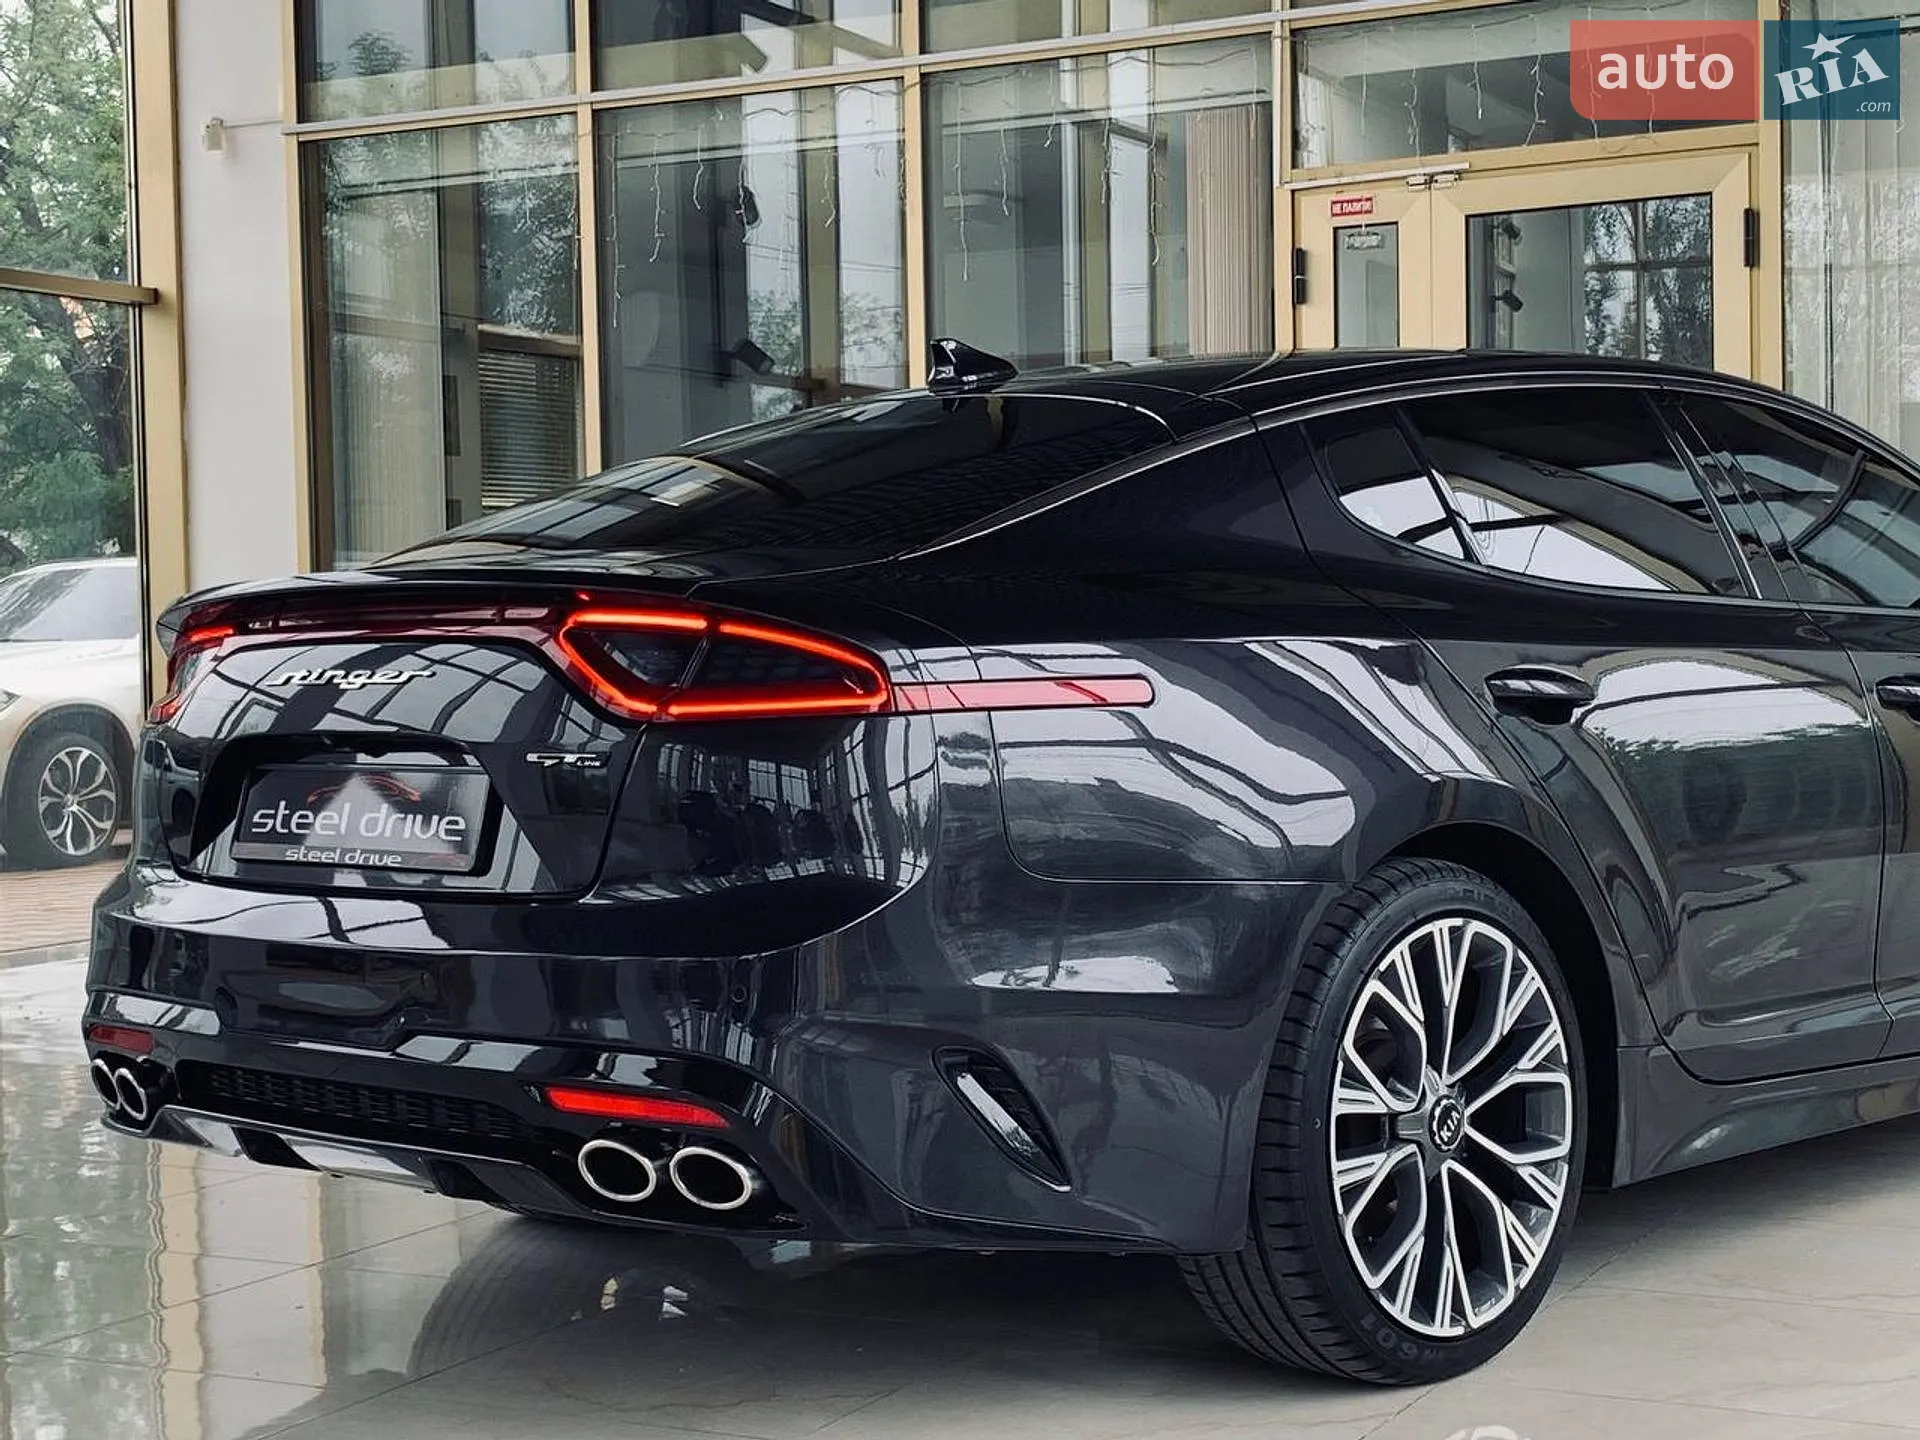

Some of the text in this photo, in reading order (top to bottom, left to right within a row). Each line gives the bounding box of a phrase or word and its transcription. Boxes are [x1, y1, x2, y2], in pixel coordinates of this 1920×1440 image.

[251, 799, 466, 841] steel drive
[284, 846, 402, 867] steel drive
